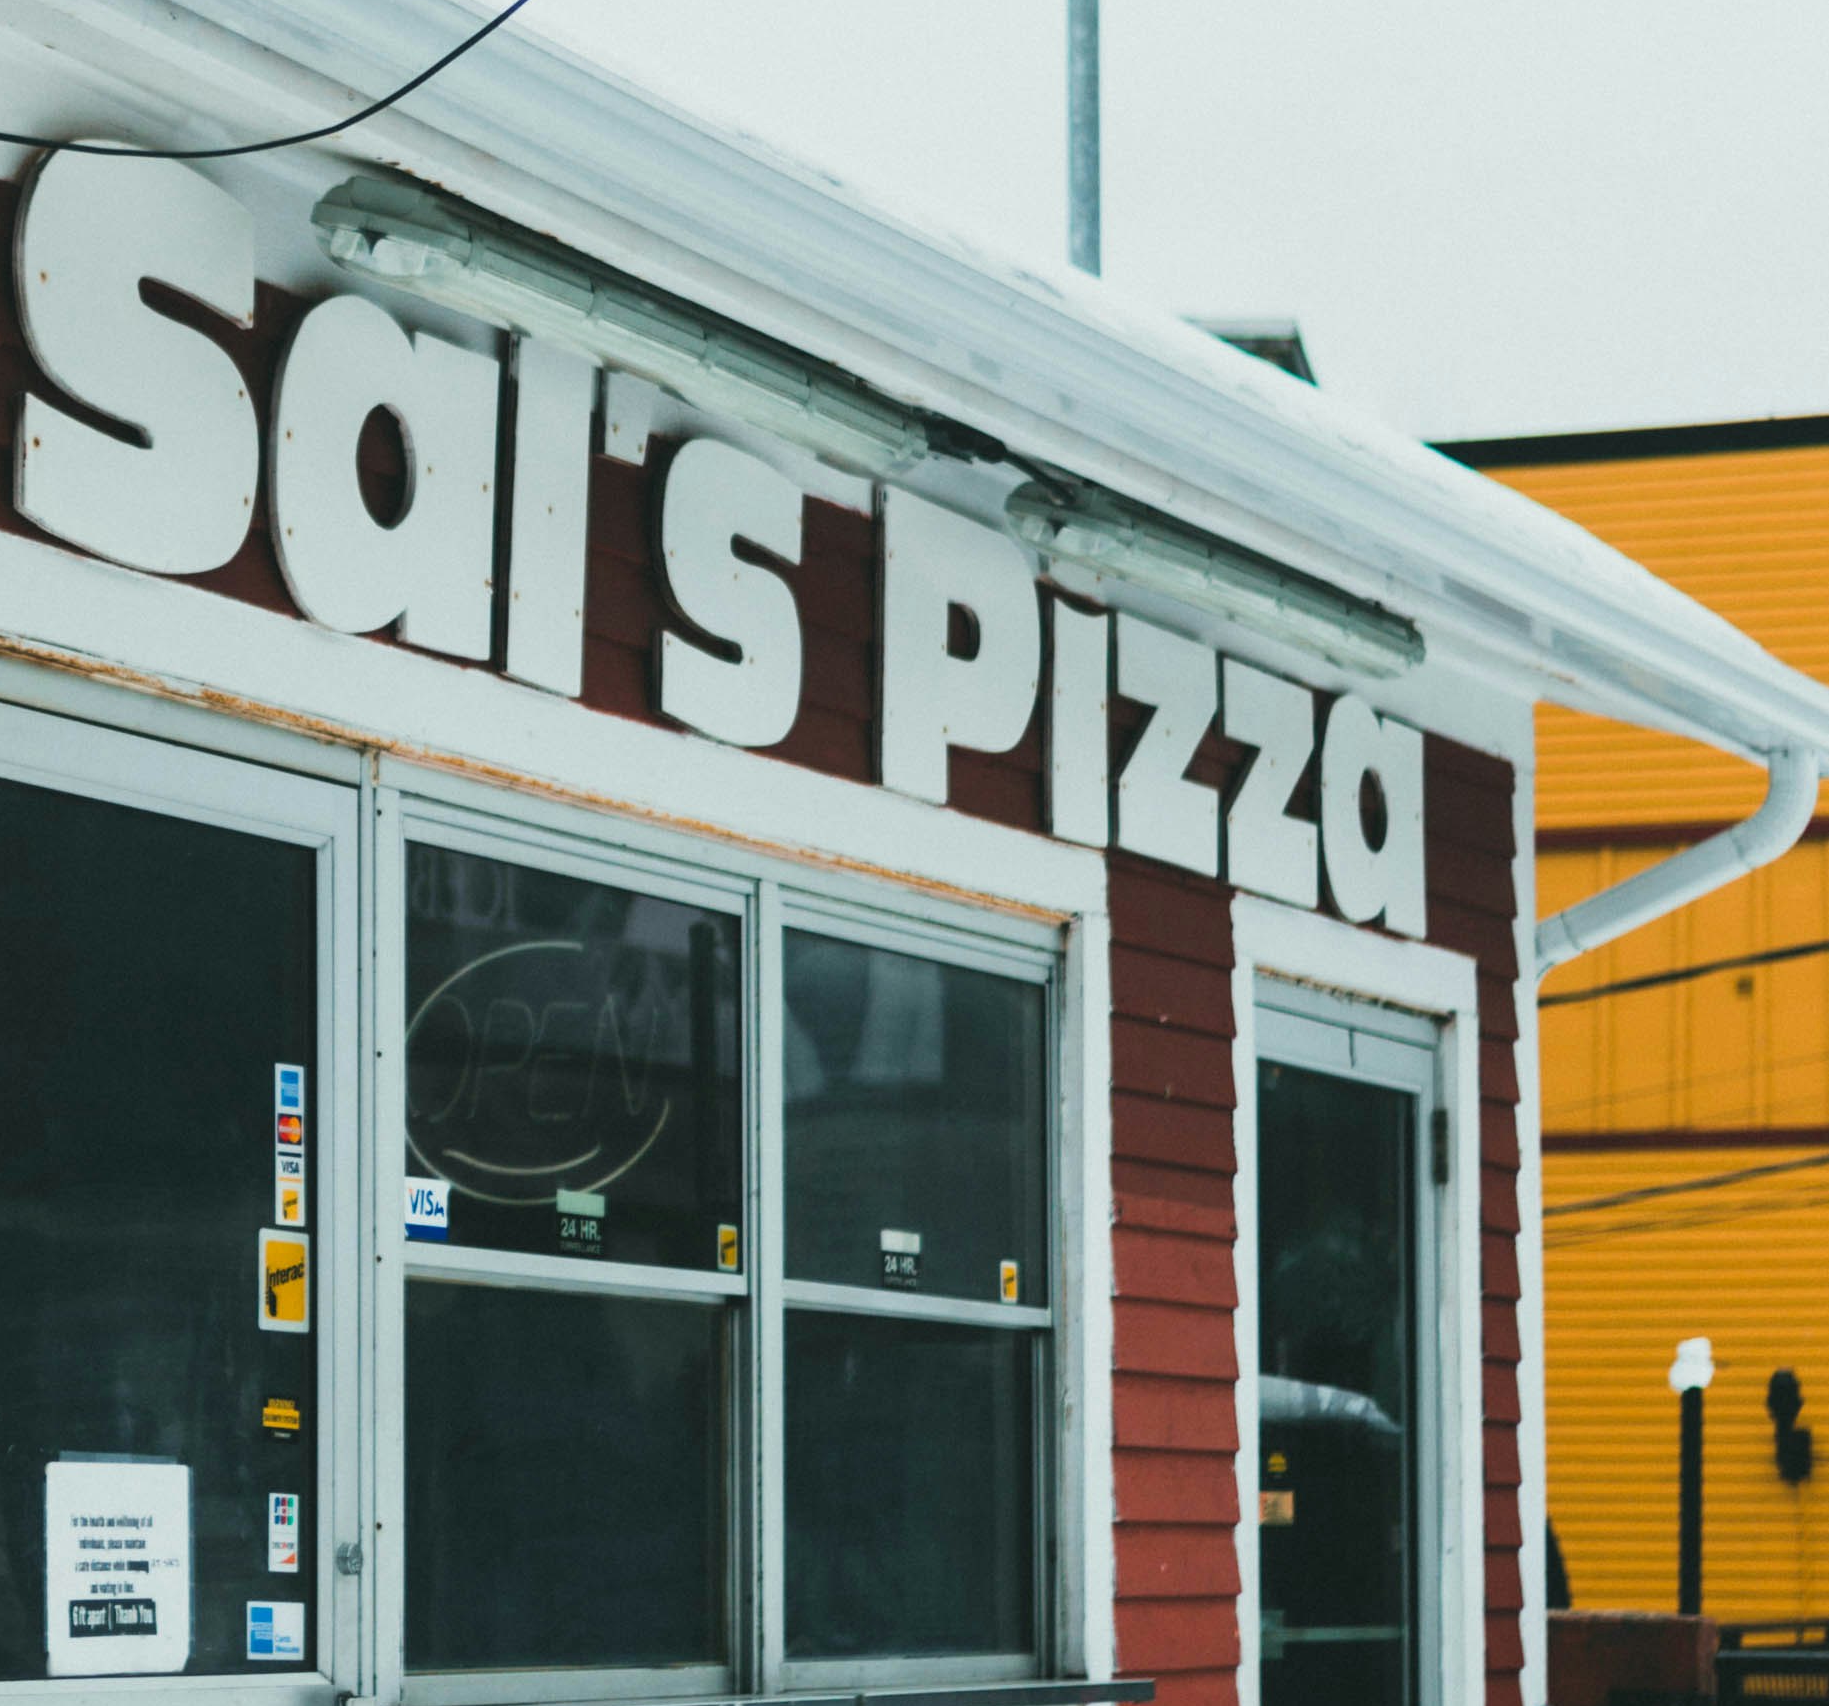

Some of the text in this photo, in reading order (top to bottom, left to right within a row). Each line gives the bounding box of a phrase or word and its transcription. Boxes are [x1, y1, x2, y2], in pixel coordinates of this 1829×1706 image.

[14, 139, 1426, 940] Sal's Pizza
[281, 1160, 300, 1174] VISA
[560, 1217, 577, 1238] 24
[883, 1255, 897, 1274] 24
